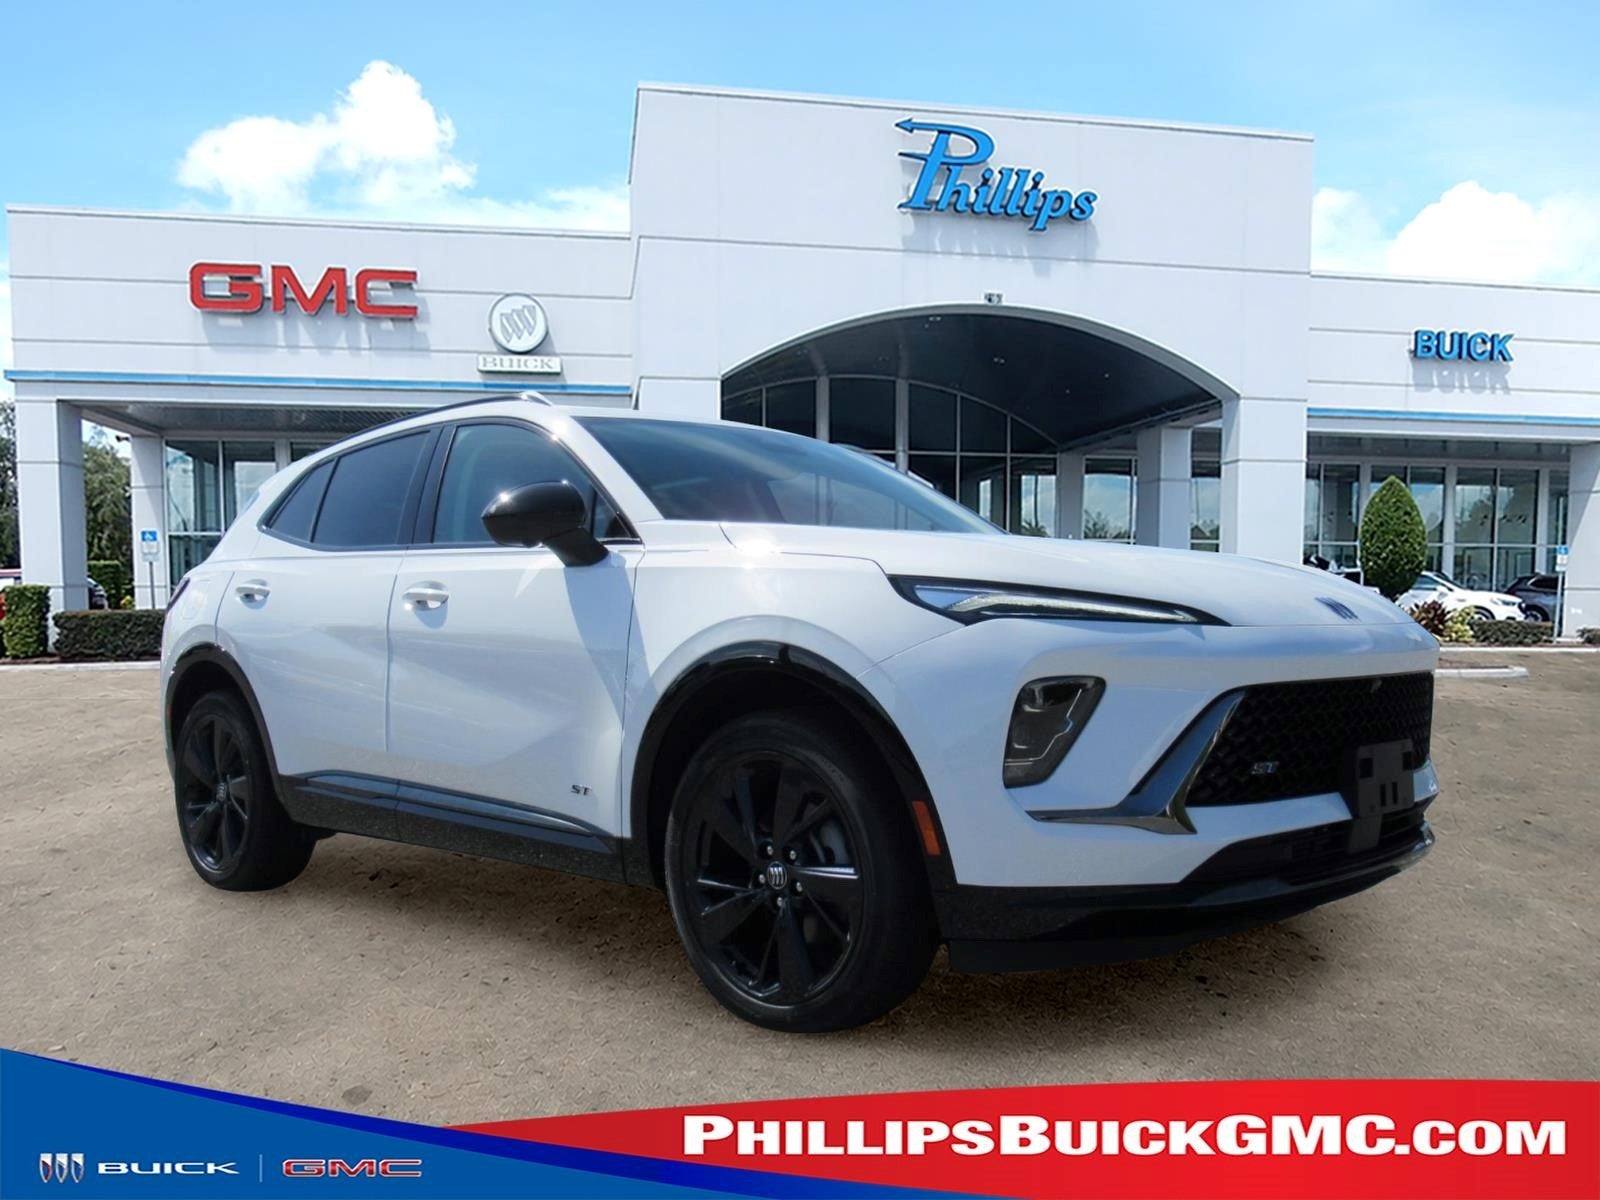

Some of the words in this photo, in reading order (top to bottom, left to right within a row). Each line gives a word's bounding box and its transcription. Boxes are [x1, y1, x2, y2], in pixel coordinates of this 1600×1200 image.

[895, 118, 1098, 232] Phillips
[189, 262, 418, 320] GMC
[1413, 329, 1514, 362] BUICK
[481, 356, 553, 369] BUICK
[570, 784, 592, 796] ST
